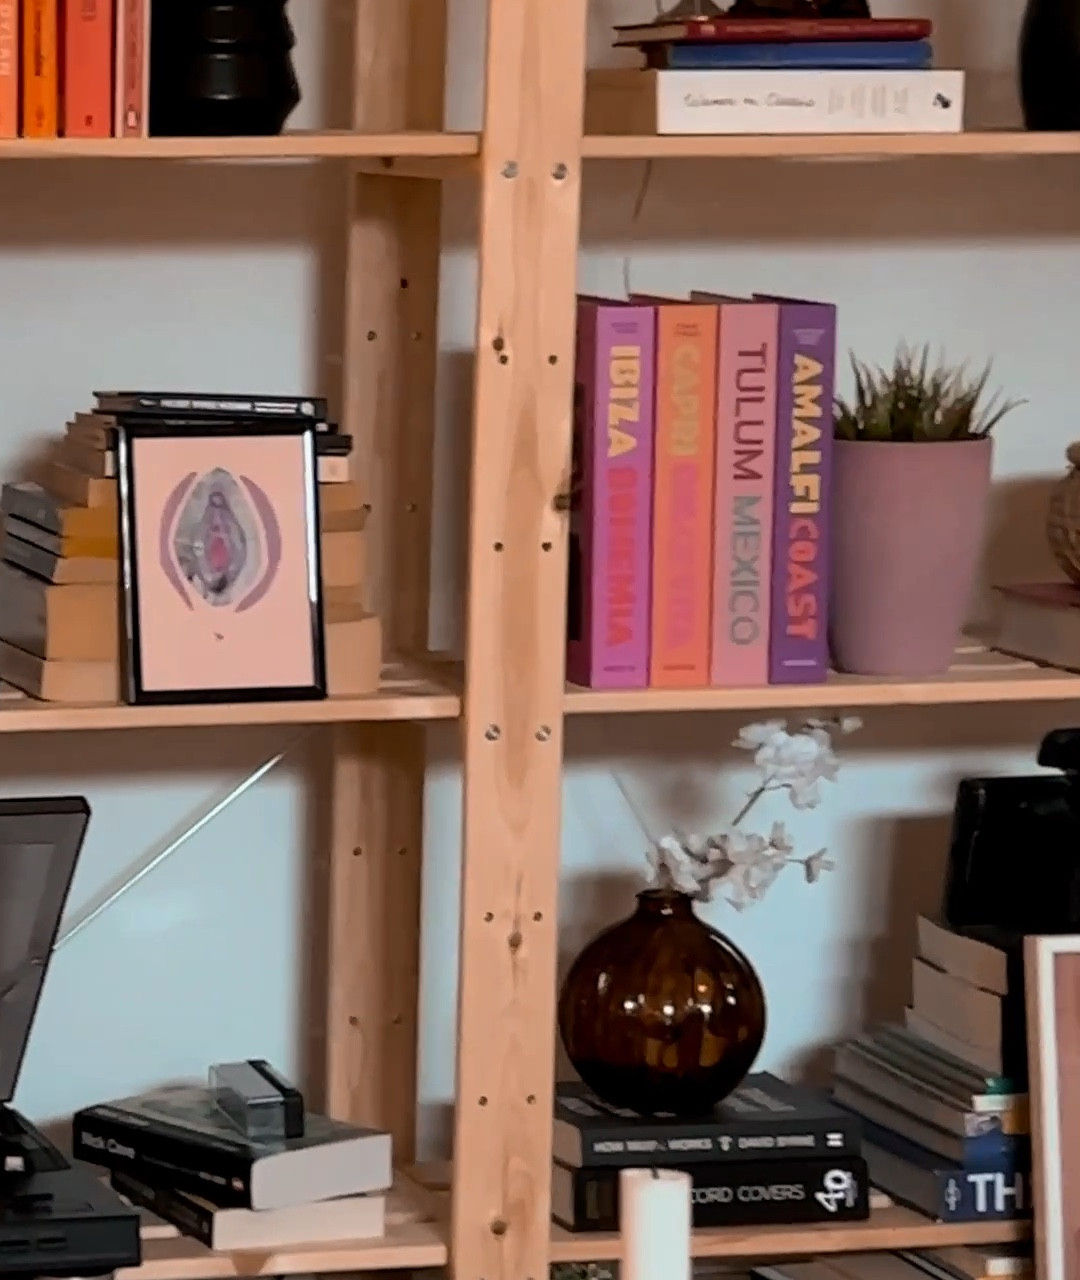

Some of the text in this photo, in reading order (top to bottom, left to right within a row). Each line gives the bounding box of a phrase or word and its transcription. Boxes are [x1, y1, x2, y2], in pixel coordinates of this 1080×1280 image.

[607, 345, 641, 458] IBIZA
[668, 344, 702, 457] CAPRI
[607, 465, 639, 647] BOHEMIA
[729, 342, 768, 646] TULUM MEXICO
[785, 353, 823, 641] AMALFI COAST
[737, 1183, 805, 1203] COVERS
